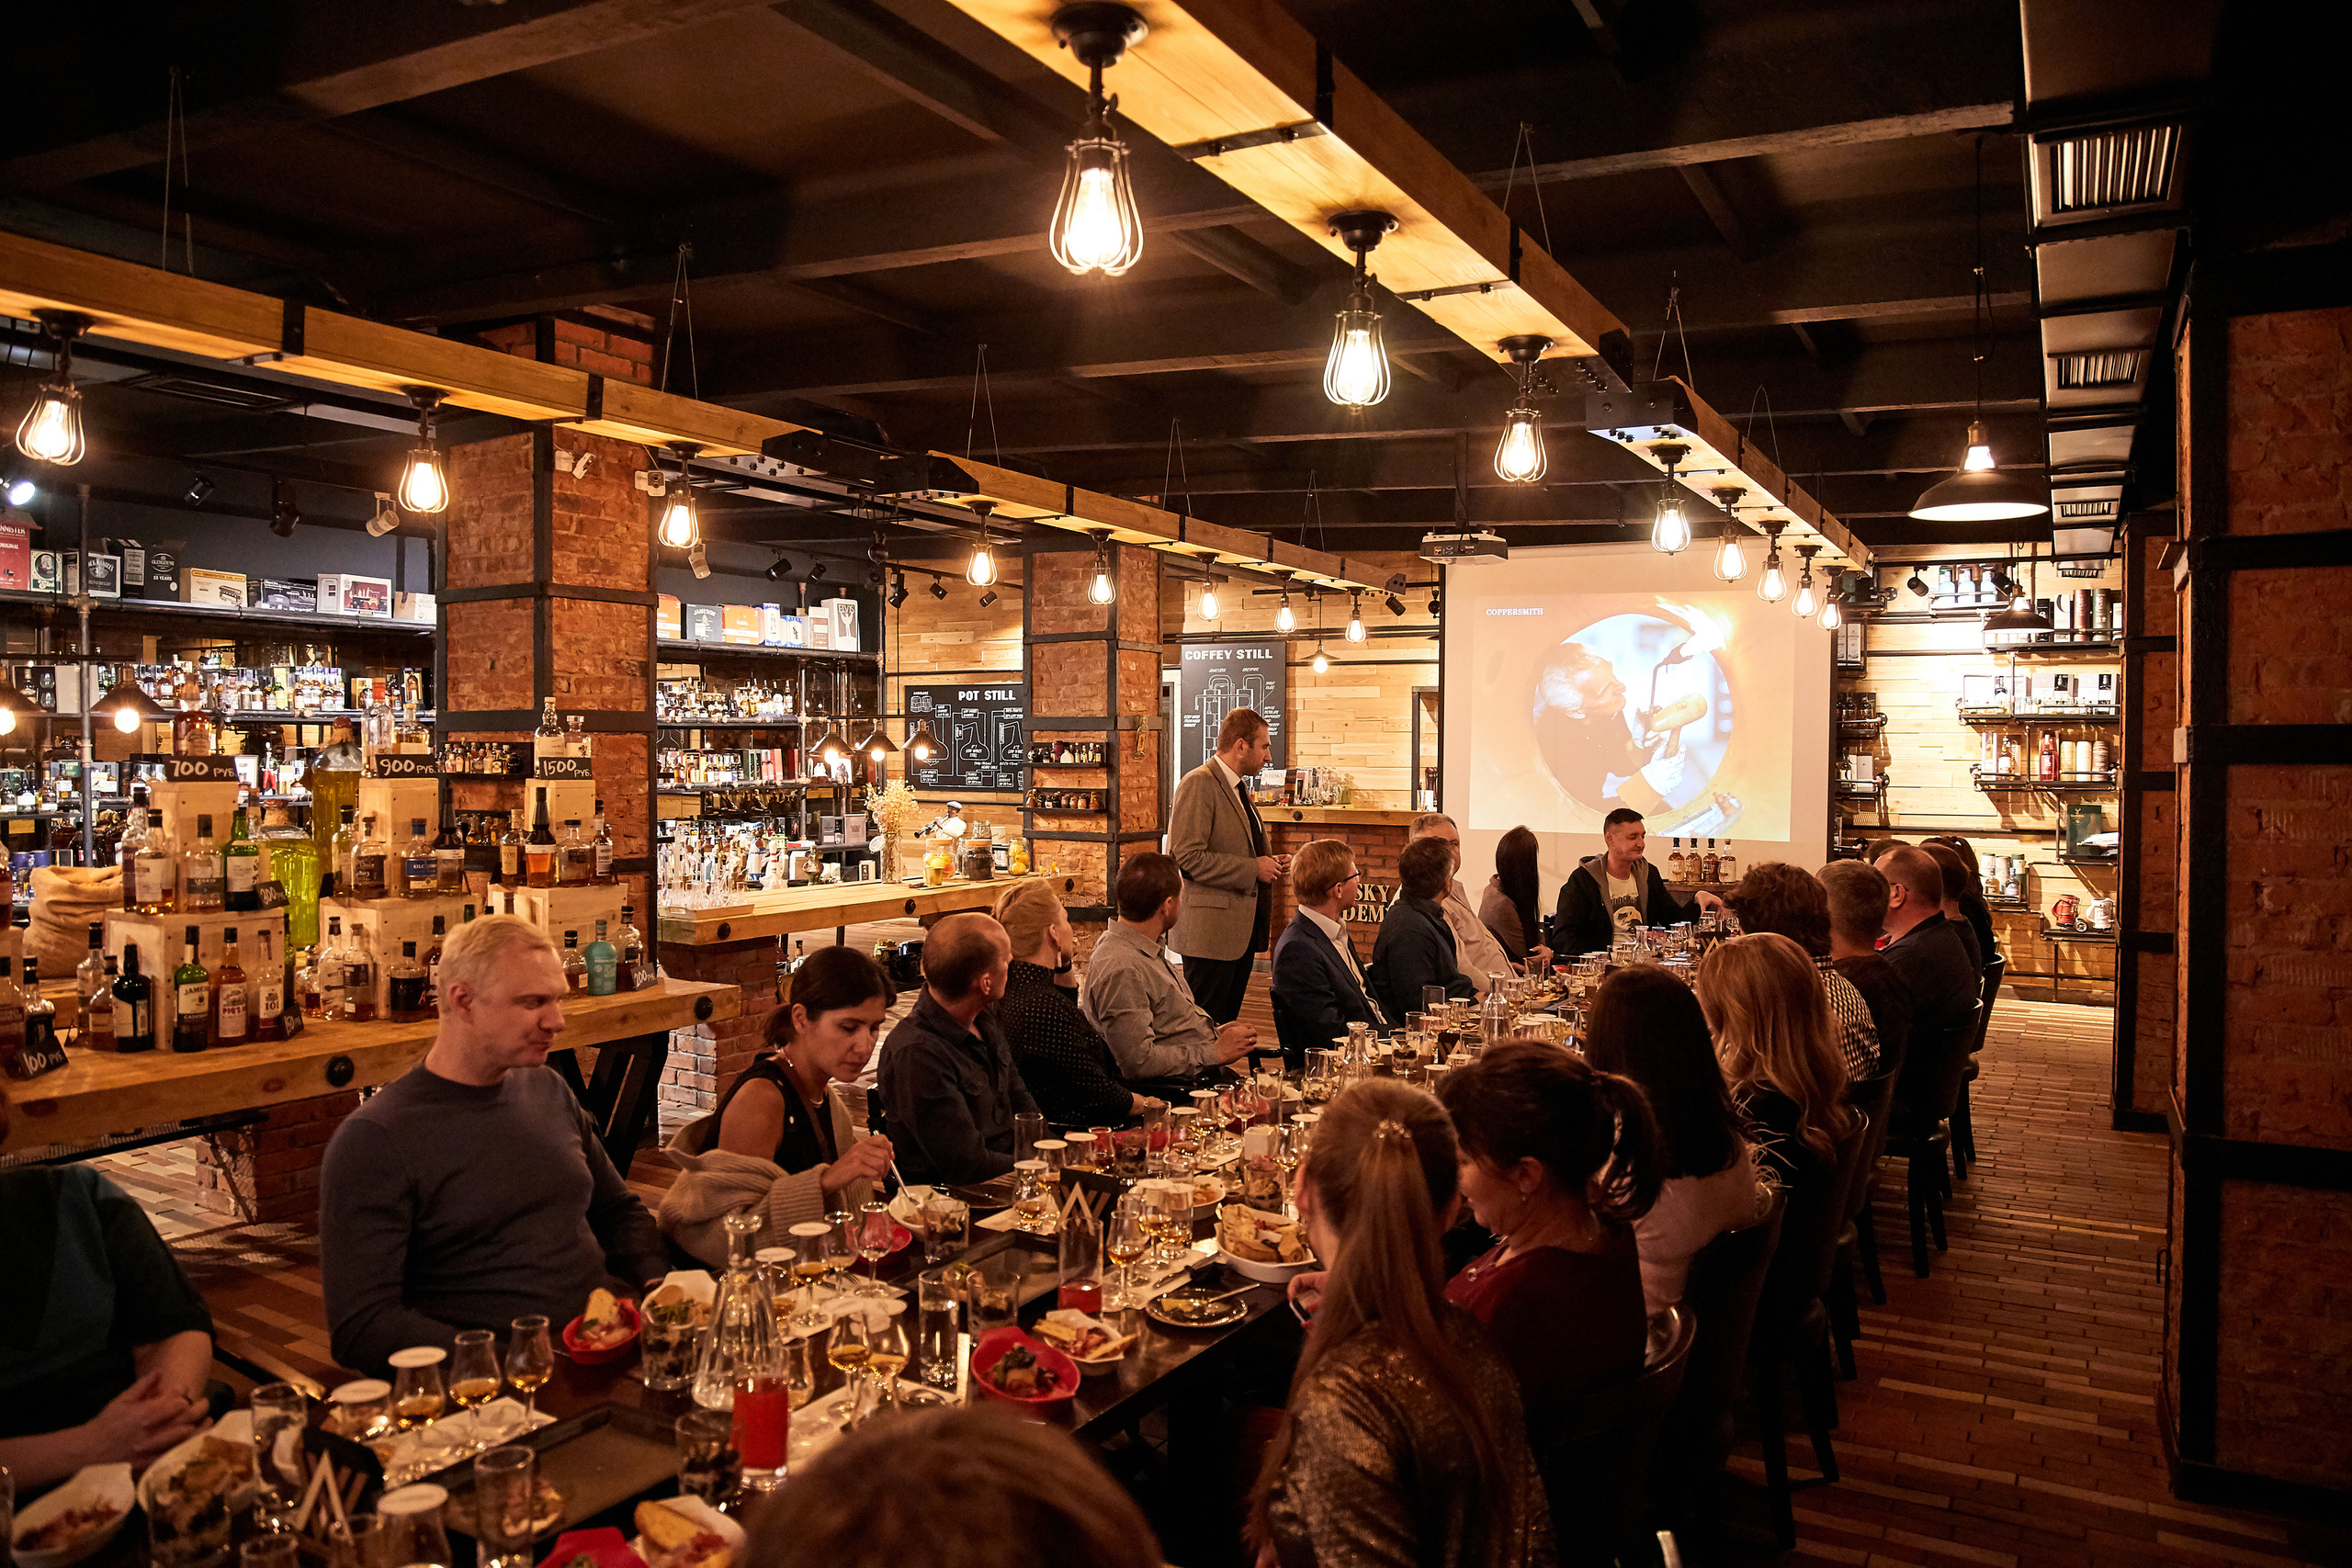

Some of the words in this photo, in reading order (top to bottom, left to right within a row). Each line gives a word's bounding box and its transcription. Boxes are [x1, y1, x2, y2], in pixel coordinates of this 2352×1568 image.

[693, 608, 717, 617] JAMESON
[838, 604, 855, 613] ELVIS
[1486, 608, 1544, 616] COPPERSMITH
[1184, 649, 1232, 660] COFFEY
[1236, 649, 1273, 660] STILL
[958, 690, 980, 701] POT
[984, 689, 1017, 701] STILL
[170, 761, 209, 777] 700
[379, 759, 415, 775] 900
[543, 759, 577, 776] 1500
[574, 769, 592, 777] РУБ.
[1355, 883, 1390, 902] SKY
[634, 970, 647, 988] 200
[265, 1001, 279, 1010] 101
[22, 1052, 47, 1075] 100
